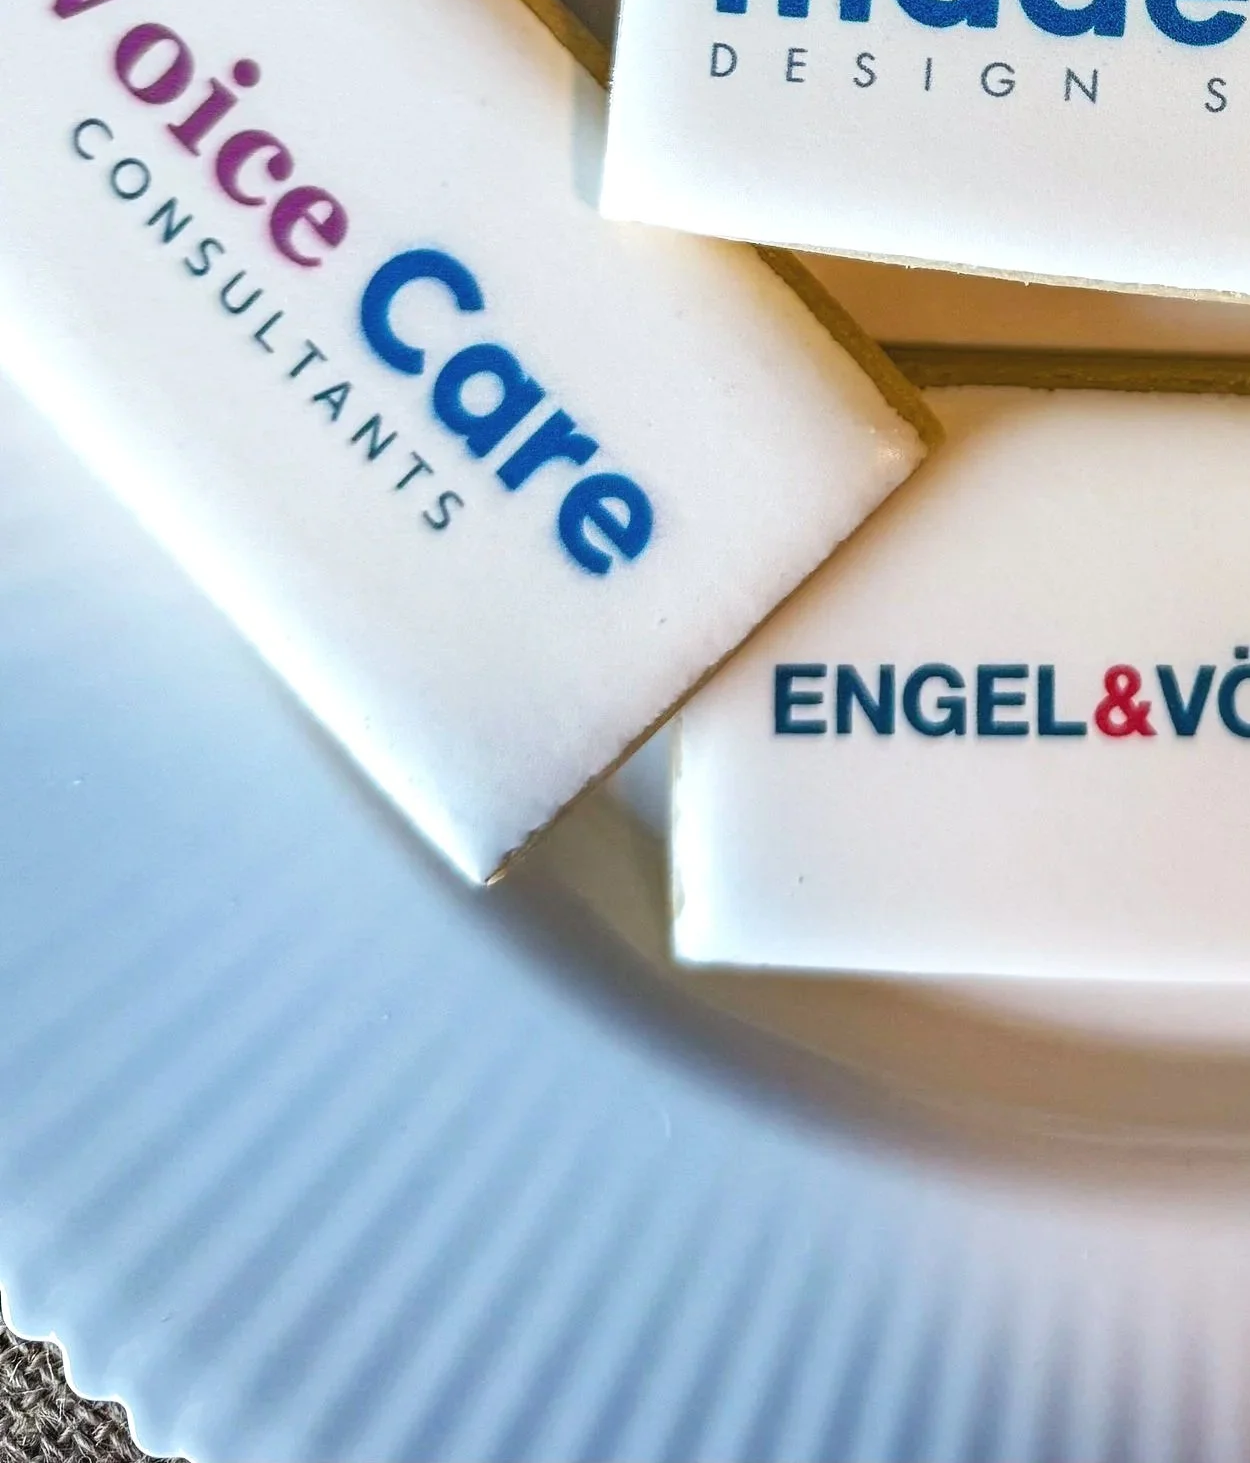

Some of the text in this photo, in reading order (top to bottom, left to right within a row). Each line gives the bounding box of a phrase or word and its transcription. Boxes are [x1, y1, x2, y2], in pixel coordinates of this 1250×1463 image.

[709, 42, 1100, 104] DESIGN
[71, 117, 466, 532] CONSULTANTS
[358, 246, 656, 577] Care
